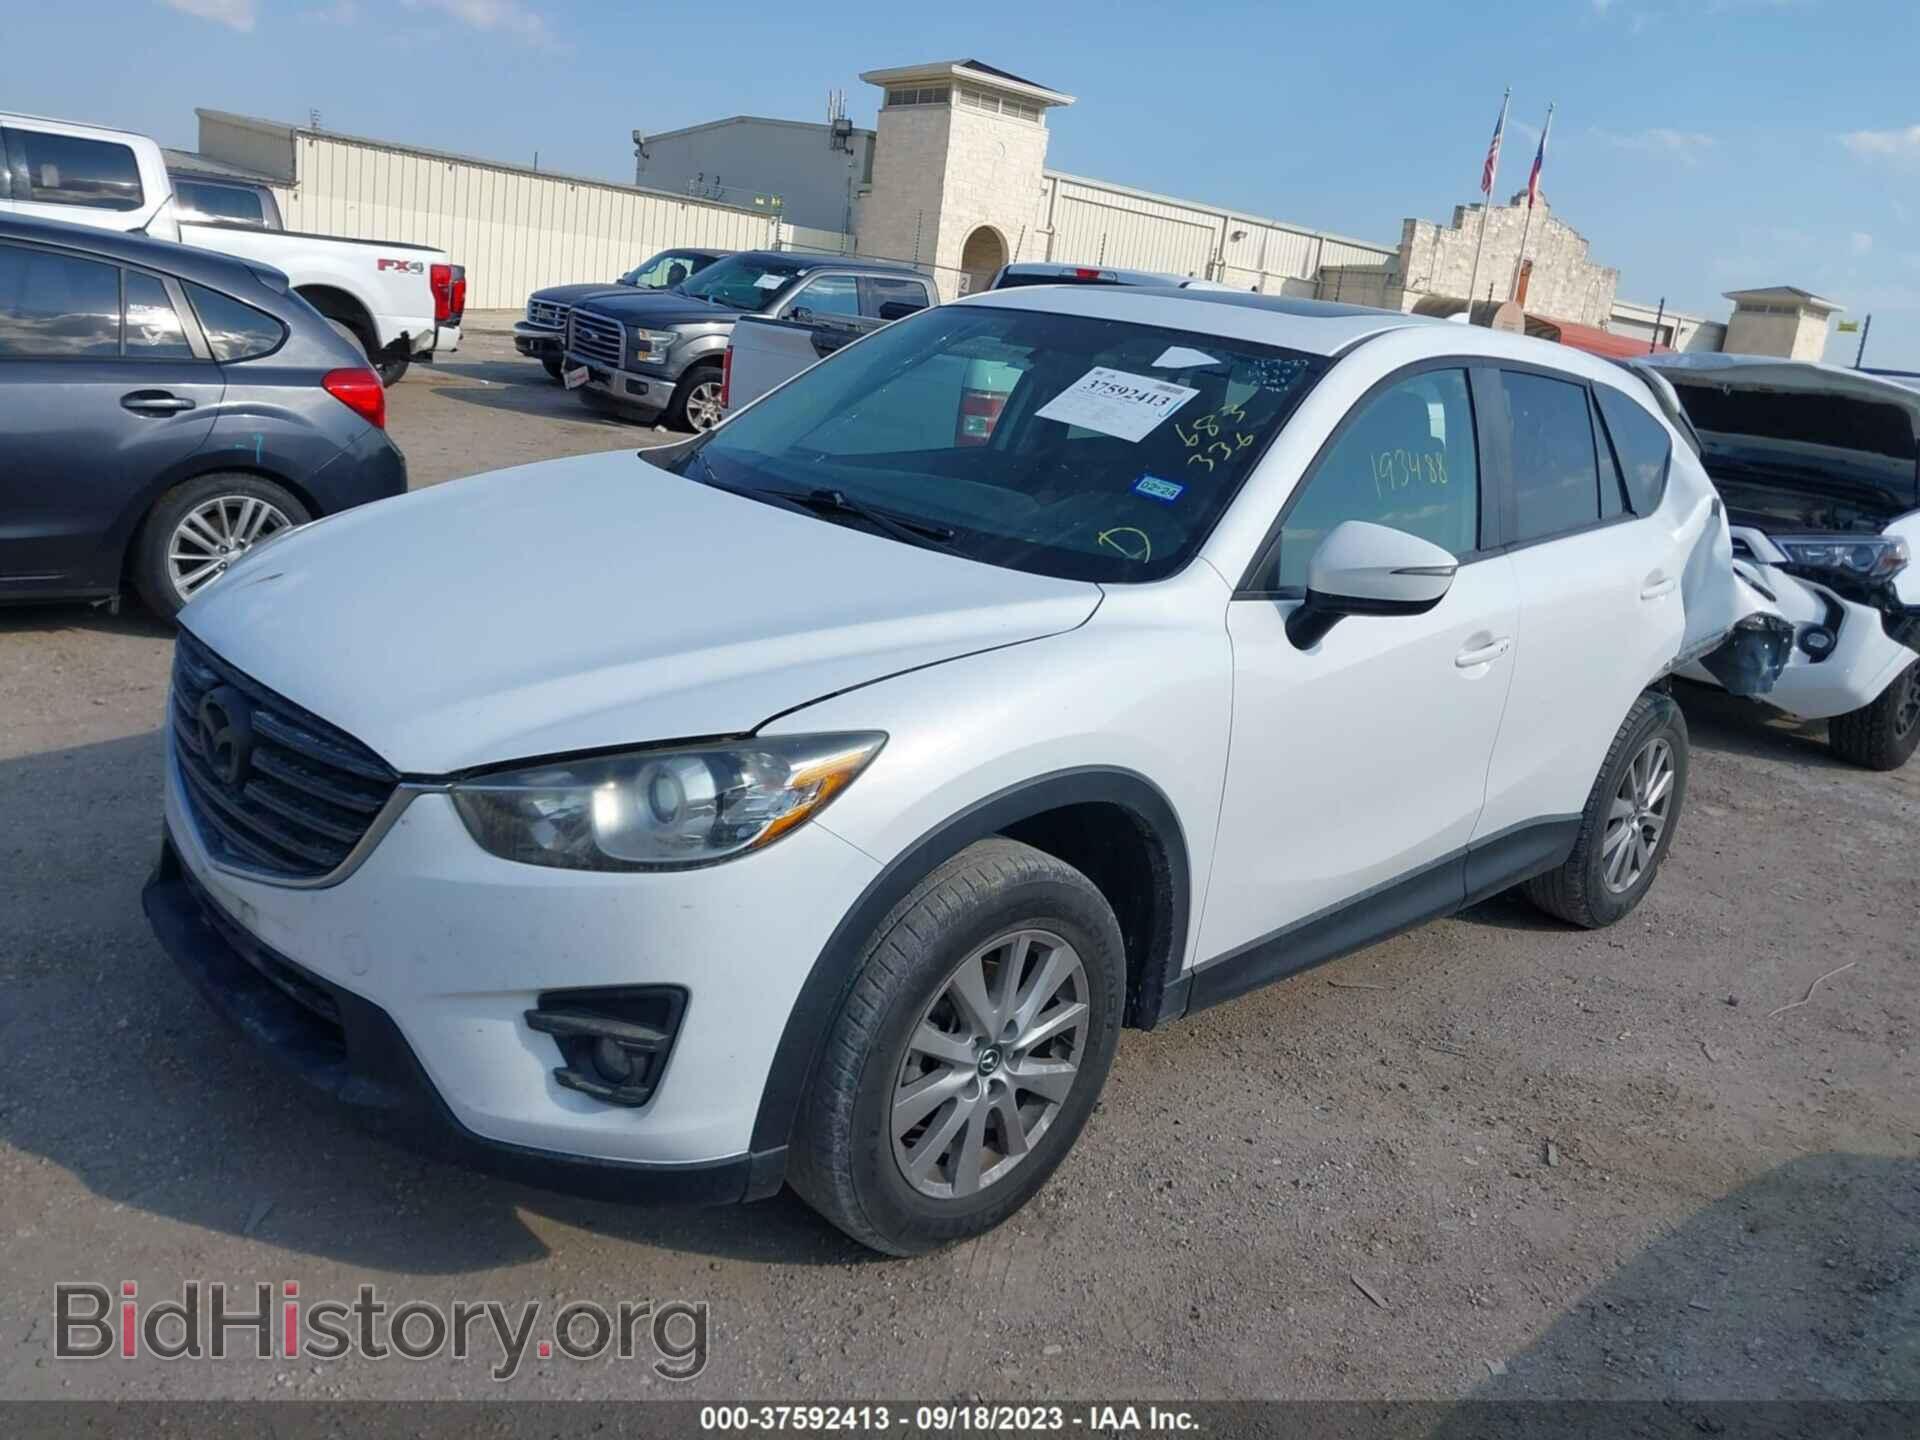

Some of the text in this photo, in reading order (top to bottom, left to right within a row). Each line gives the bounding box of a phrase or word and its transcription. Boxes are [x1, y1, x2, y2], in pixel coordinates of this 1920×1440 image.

[377, 258, 424, 274] FX4
[1083, 379, 1172, 407] 37592413
[1369, 449, 1449, 497] 193488
